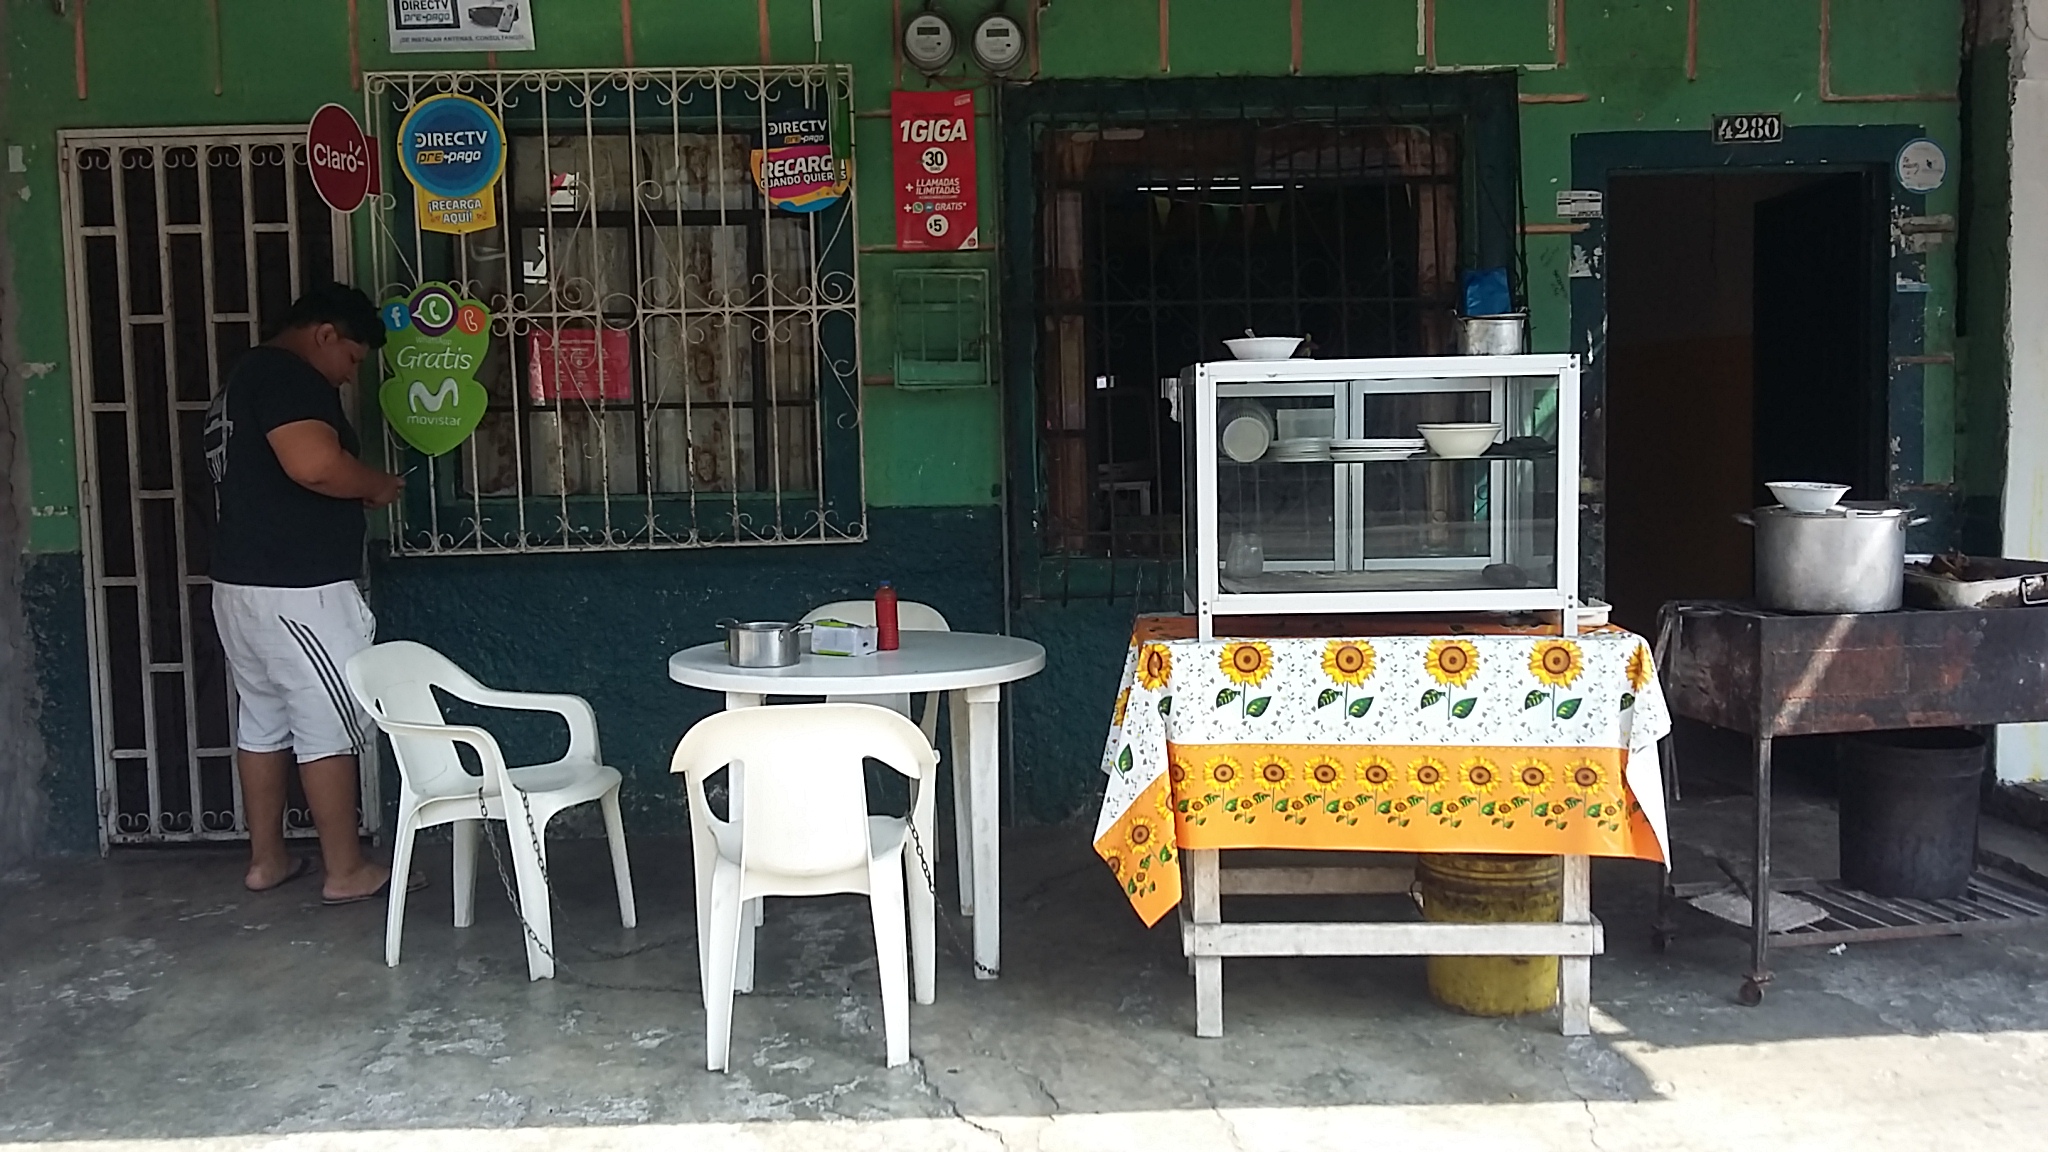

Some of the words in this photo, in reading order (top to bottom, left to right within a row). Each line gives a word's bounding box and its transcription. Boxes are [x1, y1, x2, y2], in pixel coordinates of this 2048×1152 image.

[401, 0, 448, 11] DIRECTV
[403, 12, 450, 22] pre-pago
[767, 119, 828, 136] DIRECTV
[900, 118, 968, 143] 1GIGA
[1717, 116, 1780, 141] 4280
[414, 130, 488, 148] DIRECTV
[313, 142, 358, 173] Claro
[416, 150, 482, 165] pre-pago
[925, 150, 944, 167] 30
[803, 171, 847, 185] QUIERS
[916, 178, 960, 187] LLAMADAS
[915, 186, 961, 195] ILIMITADAS
[428, 199, 482, 213] ¡RECARGA
[442, 210, 473, 224] AQUÍ!
[396, 345, 473, 370] Gratis
[406, 415, 462, 427] movistar
